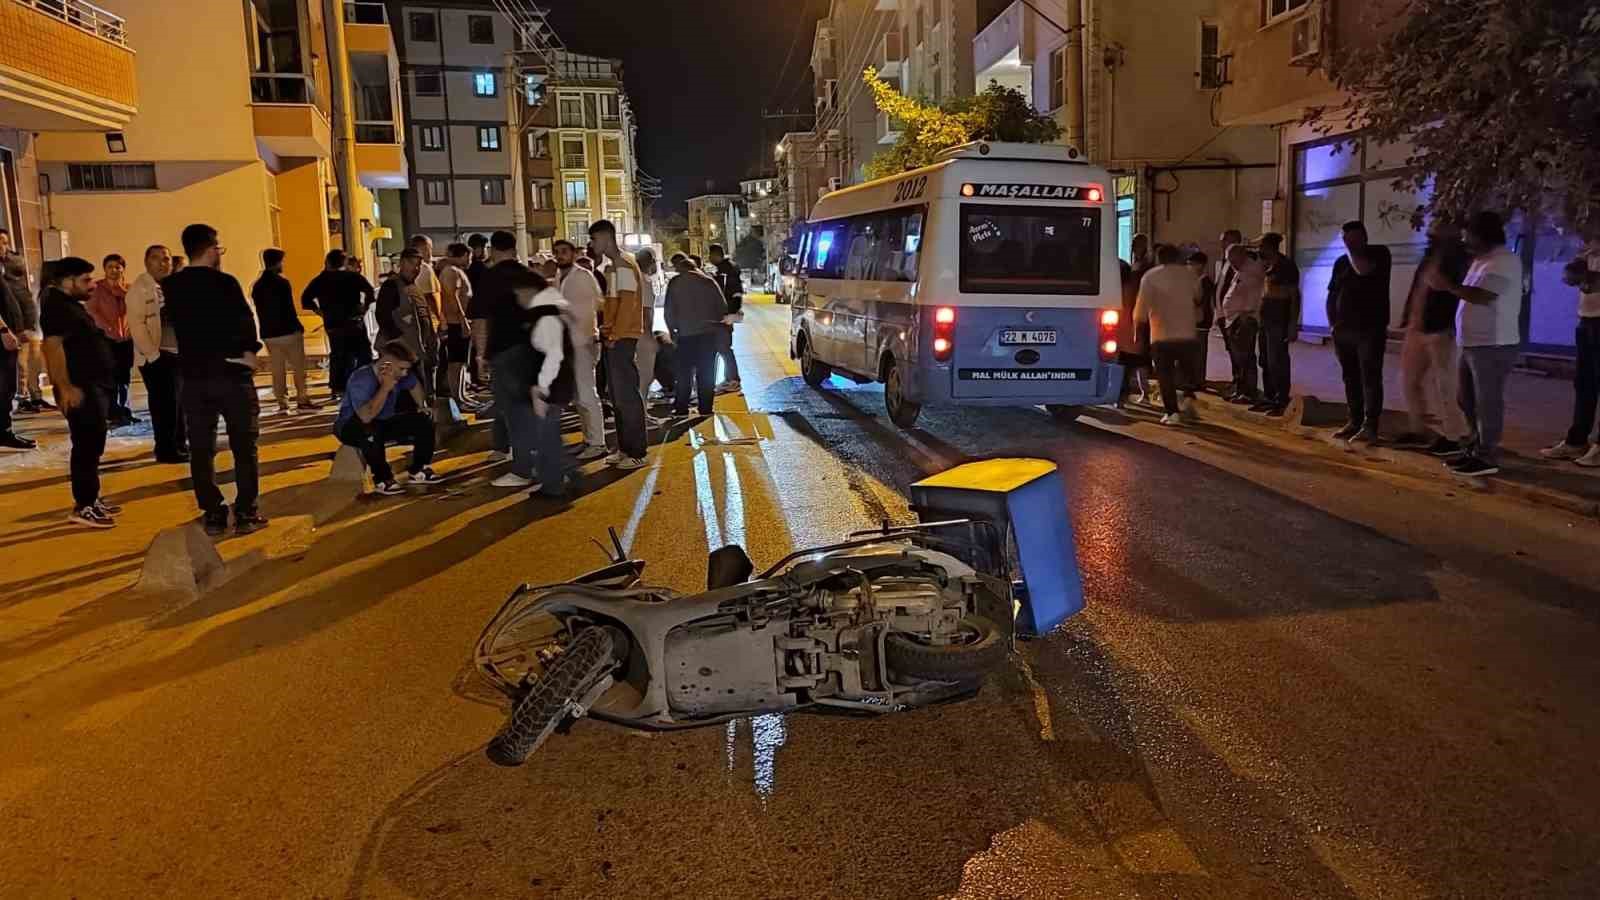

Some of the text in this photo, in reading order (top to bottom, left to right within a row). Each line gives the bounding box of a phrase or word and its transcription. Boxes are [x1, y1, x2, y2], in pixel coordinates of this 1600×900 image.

[894, 176, 927, 202] 2012
[981, 185, 1078, 199] MAŞALLAH
[1006, 332, 1016, 342] 22
[1032, 332, 1055, 342] 4076
[993, 371, 1018, 379] MÜLK
